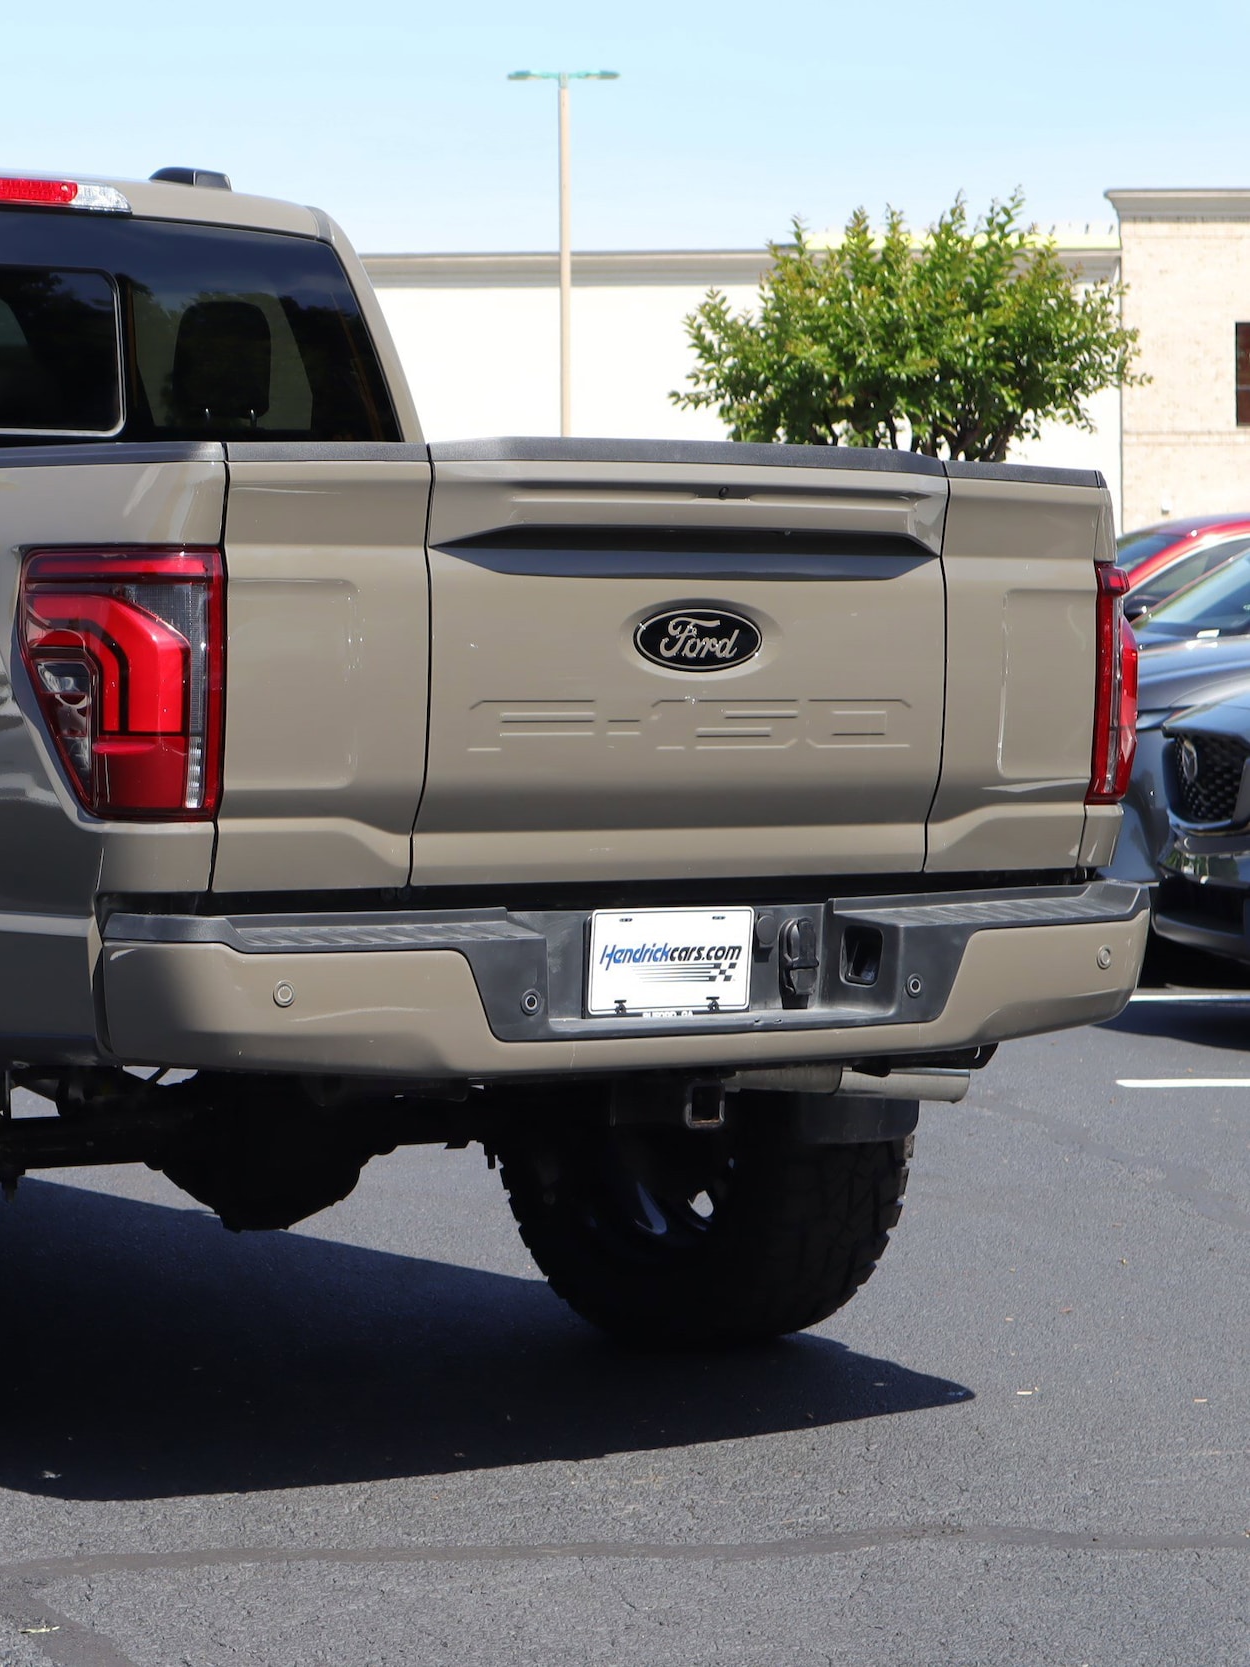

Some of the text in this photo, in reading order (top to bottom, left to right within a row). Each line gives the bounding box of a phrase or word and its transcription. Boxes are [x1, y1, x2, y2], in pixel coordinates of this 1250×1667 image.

[659, 617, 740, 658] Ford
[467, 698, 912, 751] F-150
[599, 943, 742, 971] Hendrickcars.com
